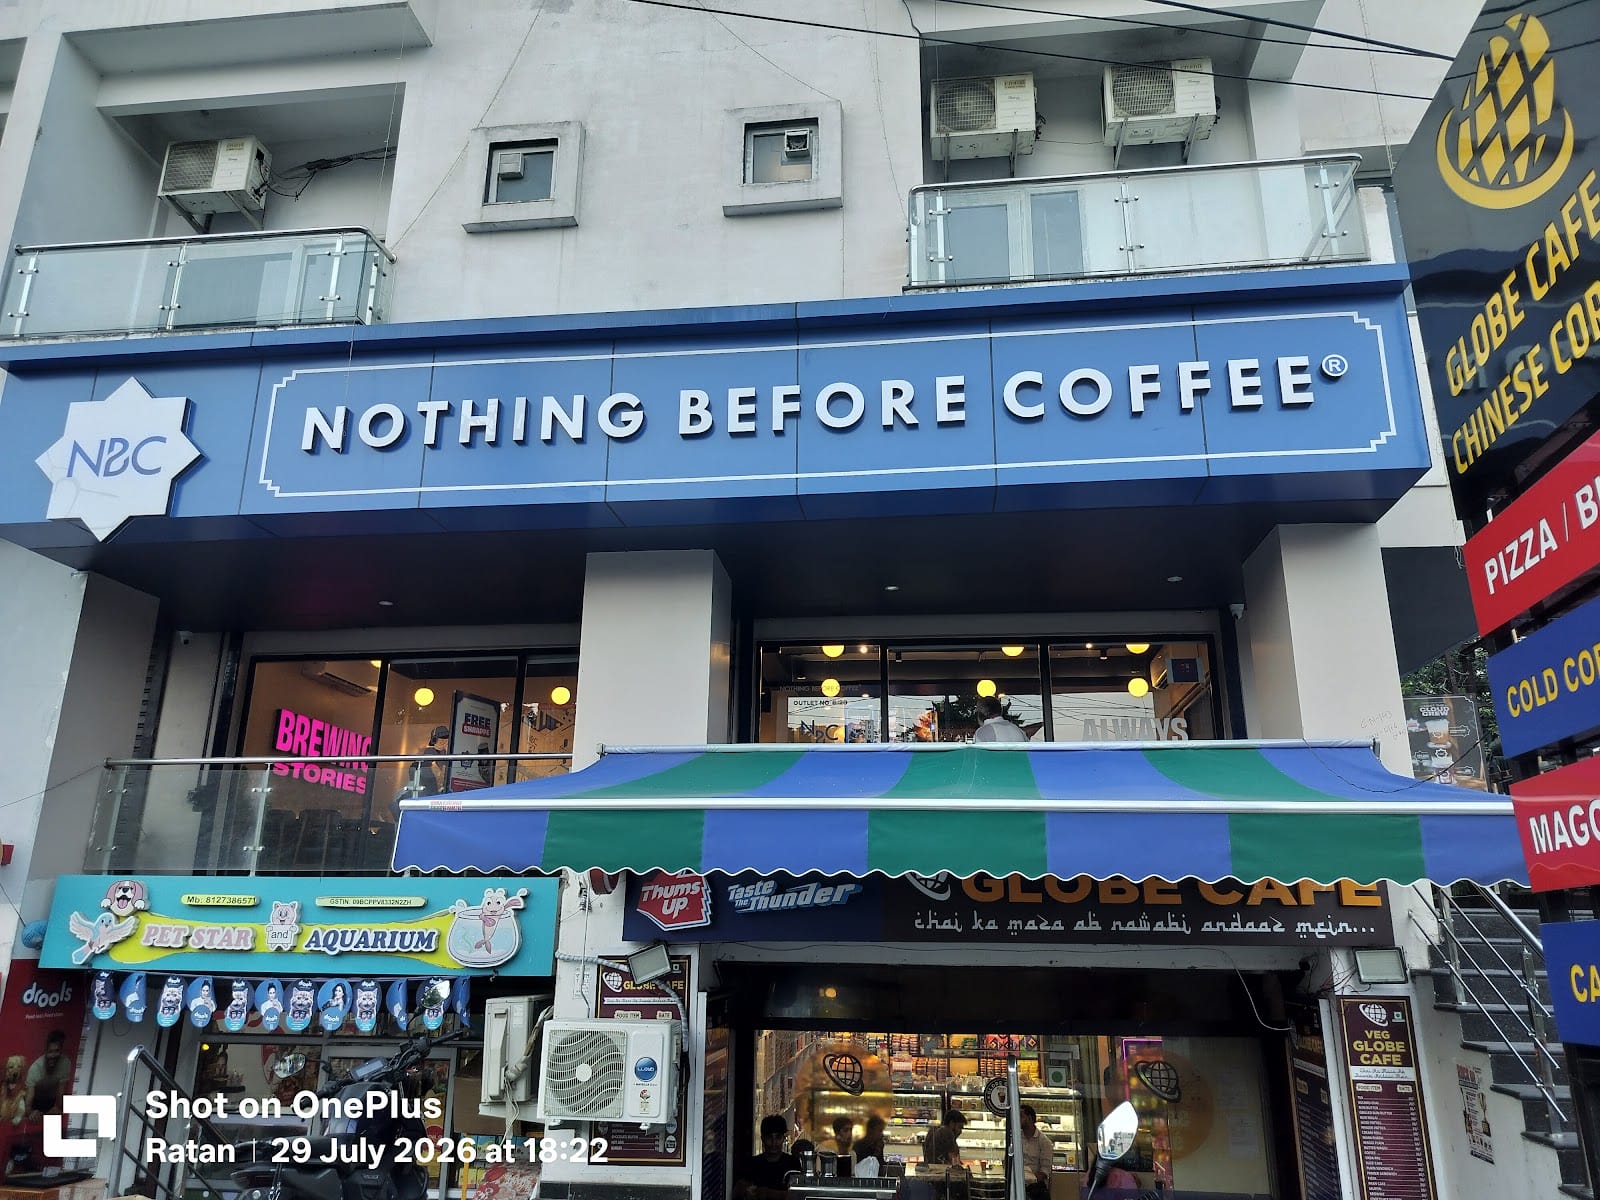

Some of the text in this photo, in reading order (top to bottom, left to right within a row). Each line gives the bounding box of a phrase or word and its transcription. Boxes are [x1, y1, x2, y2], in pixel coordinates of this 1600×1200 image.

[1445, 168, 1600, 397] GLOBE CAFE
[301, 392, 645, 454] NOTHING
[678, 375, 967, 435] BEFORE
[1451, 344, 1551, 476] CHINESE
[66, 436, 167, 478] NBC
[1484, 518, 1558, 595] PIZZA
[1576, 475, 1600, 530] B
[1506, 667, 1559, 718] COLD
[464, 712, 492, 726] FREE
[641, 881, 702, 902] Thums
[728, 880, 776, 901] Taste
[736, 881, 857, 913] Thunder
[270, 929, 290, 940] and
[914, 909, 963, 933] chai
[972, 909, 999, 931] ka
[1073, 910, 1102, 931] ab
[1111, 910, 1192, 935] nawabi
[1201, 911, 1286, 933] andaaz
[142, 924, 252, 948] PET STAR
[305, 929, 437, 951] AQUARIUM
[23, 980, 73, 1008] drools
[1353, 1040, 1406, 1053] GLOBE
[1364, 1030, 1391, 1040] VEG
[1359, 1053, 1402, 1066] CAFE
